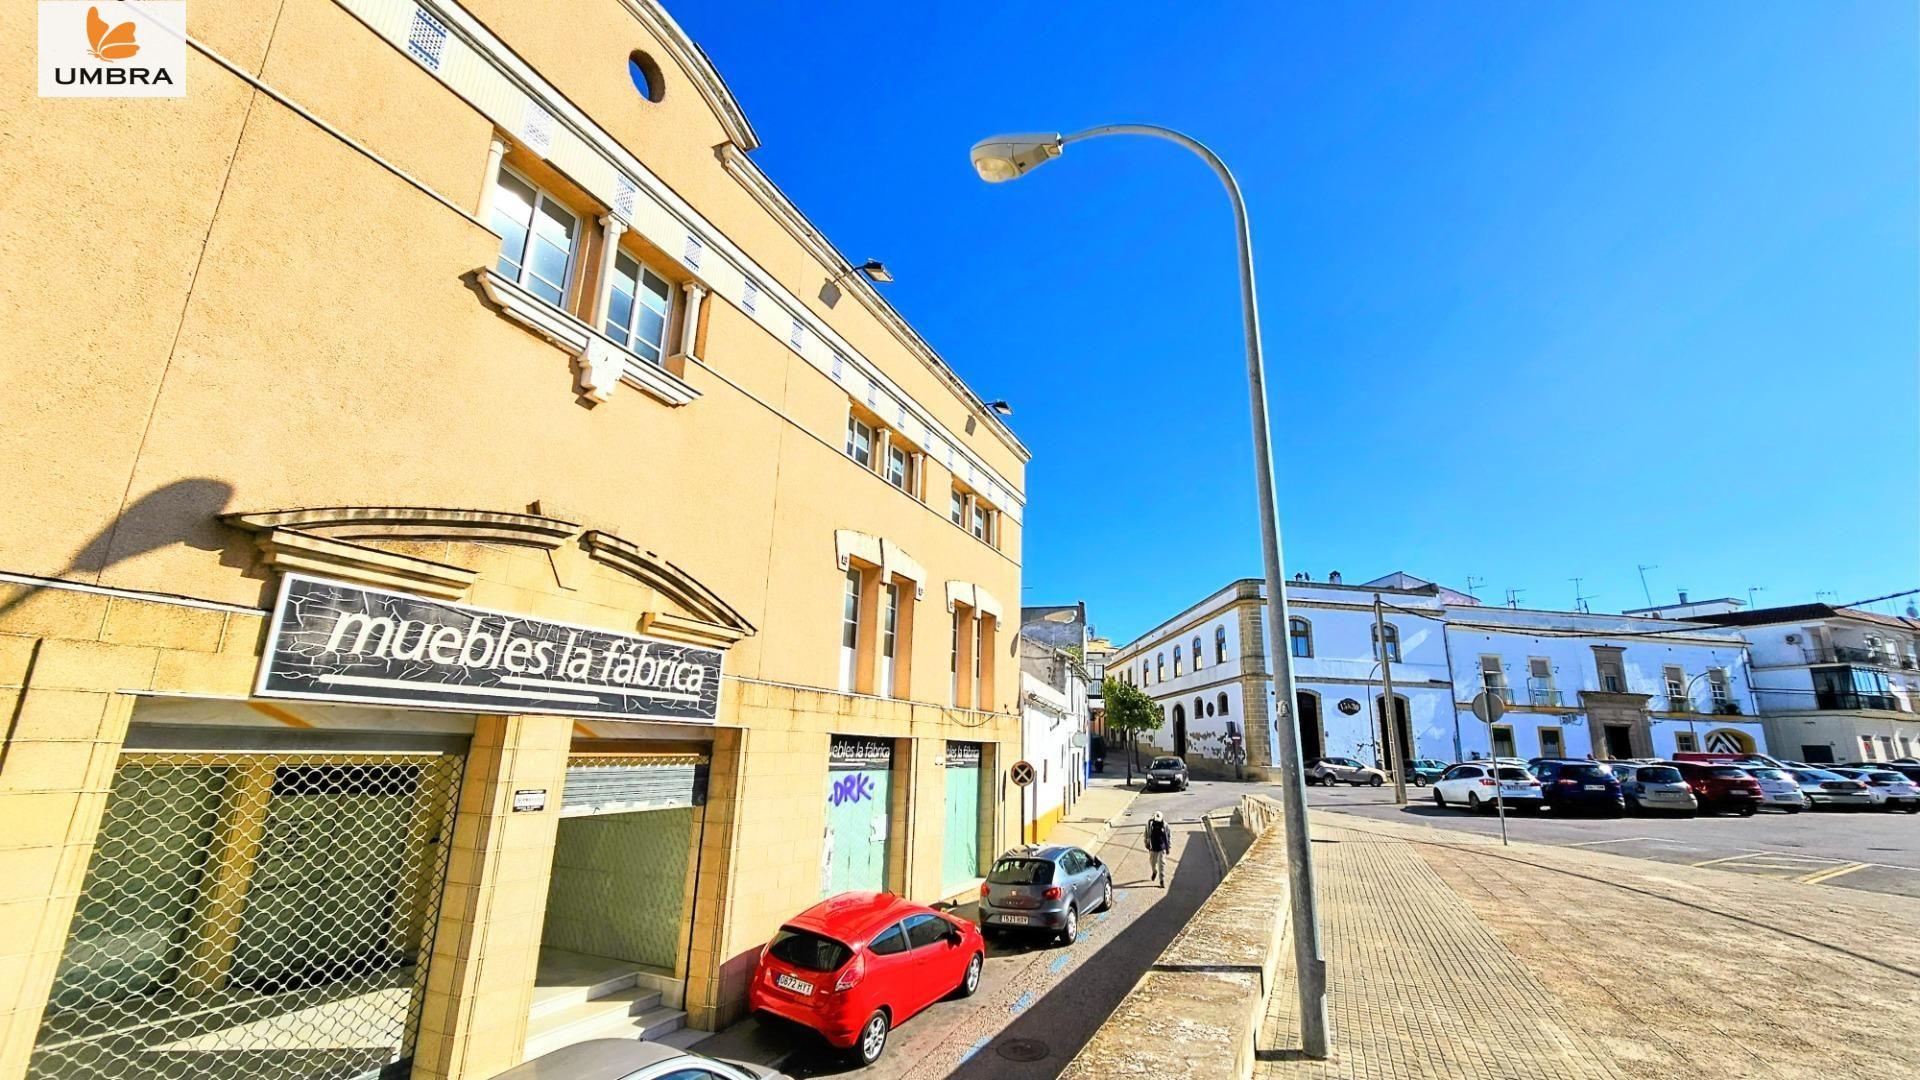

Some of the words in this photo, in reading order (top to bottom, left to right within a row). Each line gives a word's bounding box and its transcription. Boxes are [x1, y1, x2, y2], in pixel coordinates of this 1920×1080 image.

[325, 612, 553, 675] muebles
[556, 631, 593, 679] la
[601, 638, 705, 692] fábrica
[780, 975, 797, 989] 0672
